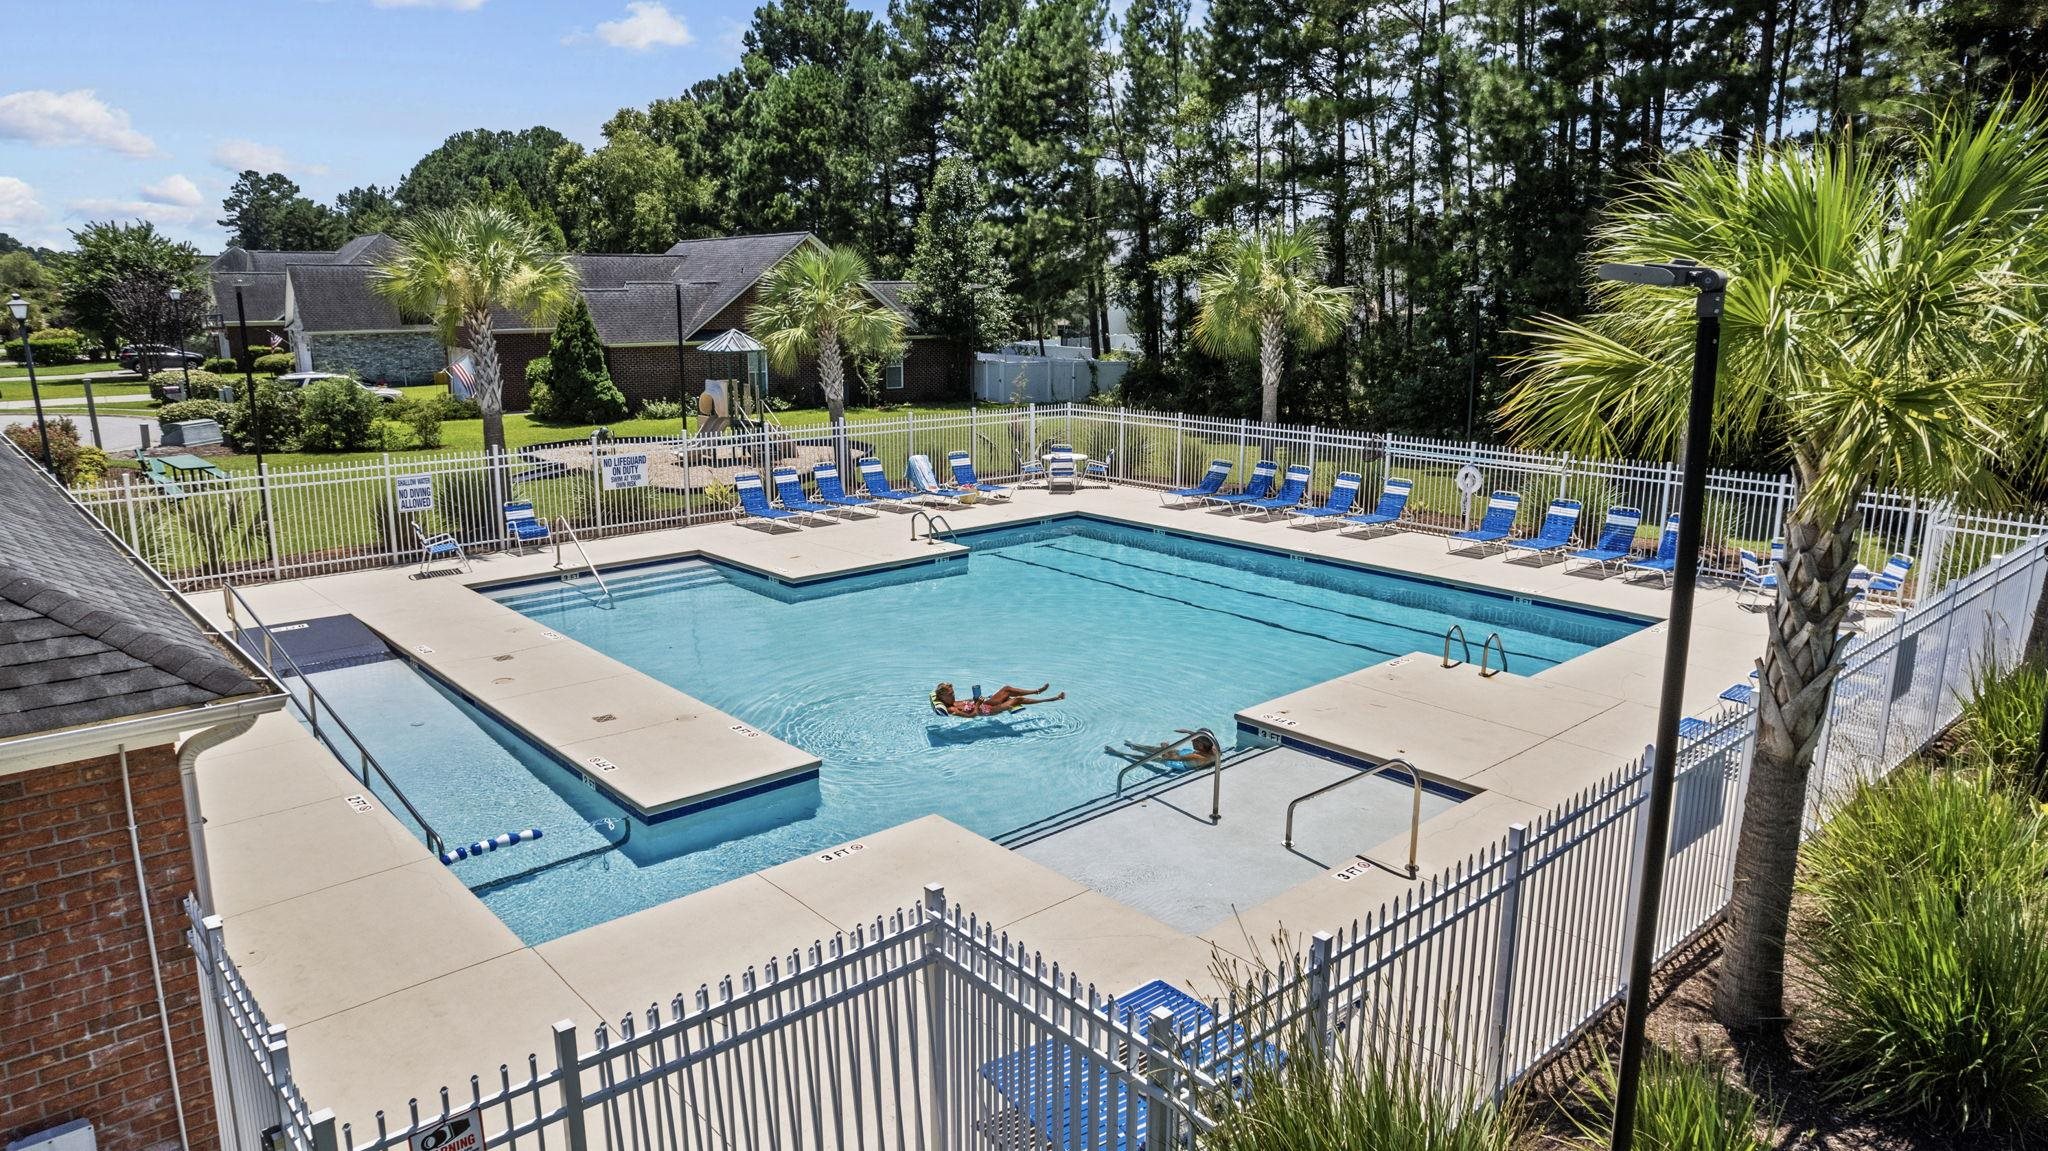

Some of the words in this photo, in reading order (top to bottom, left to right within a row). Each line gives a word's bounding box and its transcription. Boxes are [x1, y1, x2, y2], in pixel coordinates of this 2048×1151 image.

[604, 458, 612, 468] NO
[614, 456, 646, 466] LIFEGUARD
[612, 467, 621, 476] ON
[622, 465, 638, 474] DUTY
[399, 489, 408, 499] NO
[410, 487, 431, 498] DIVING
[401, 497, 431, 509] ALLOWED
[1270, 733, 1280, 741] FT
[834, 849, 849, 857] FT
[1345, 866, 1363, 875] FT
[437, 1134, 476, 1151] NING
